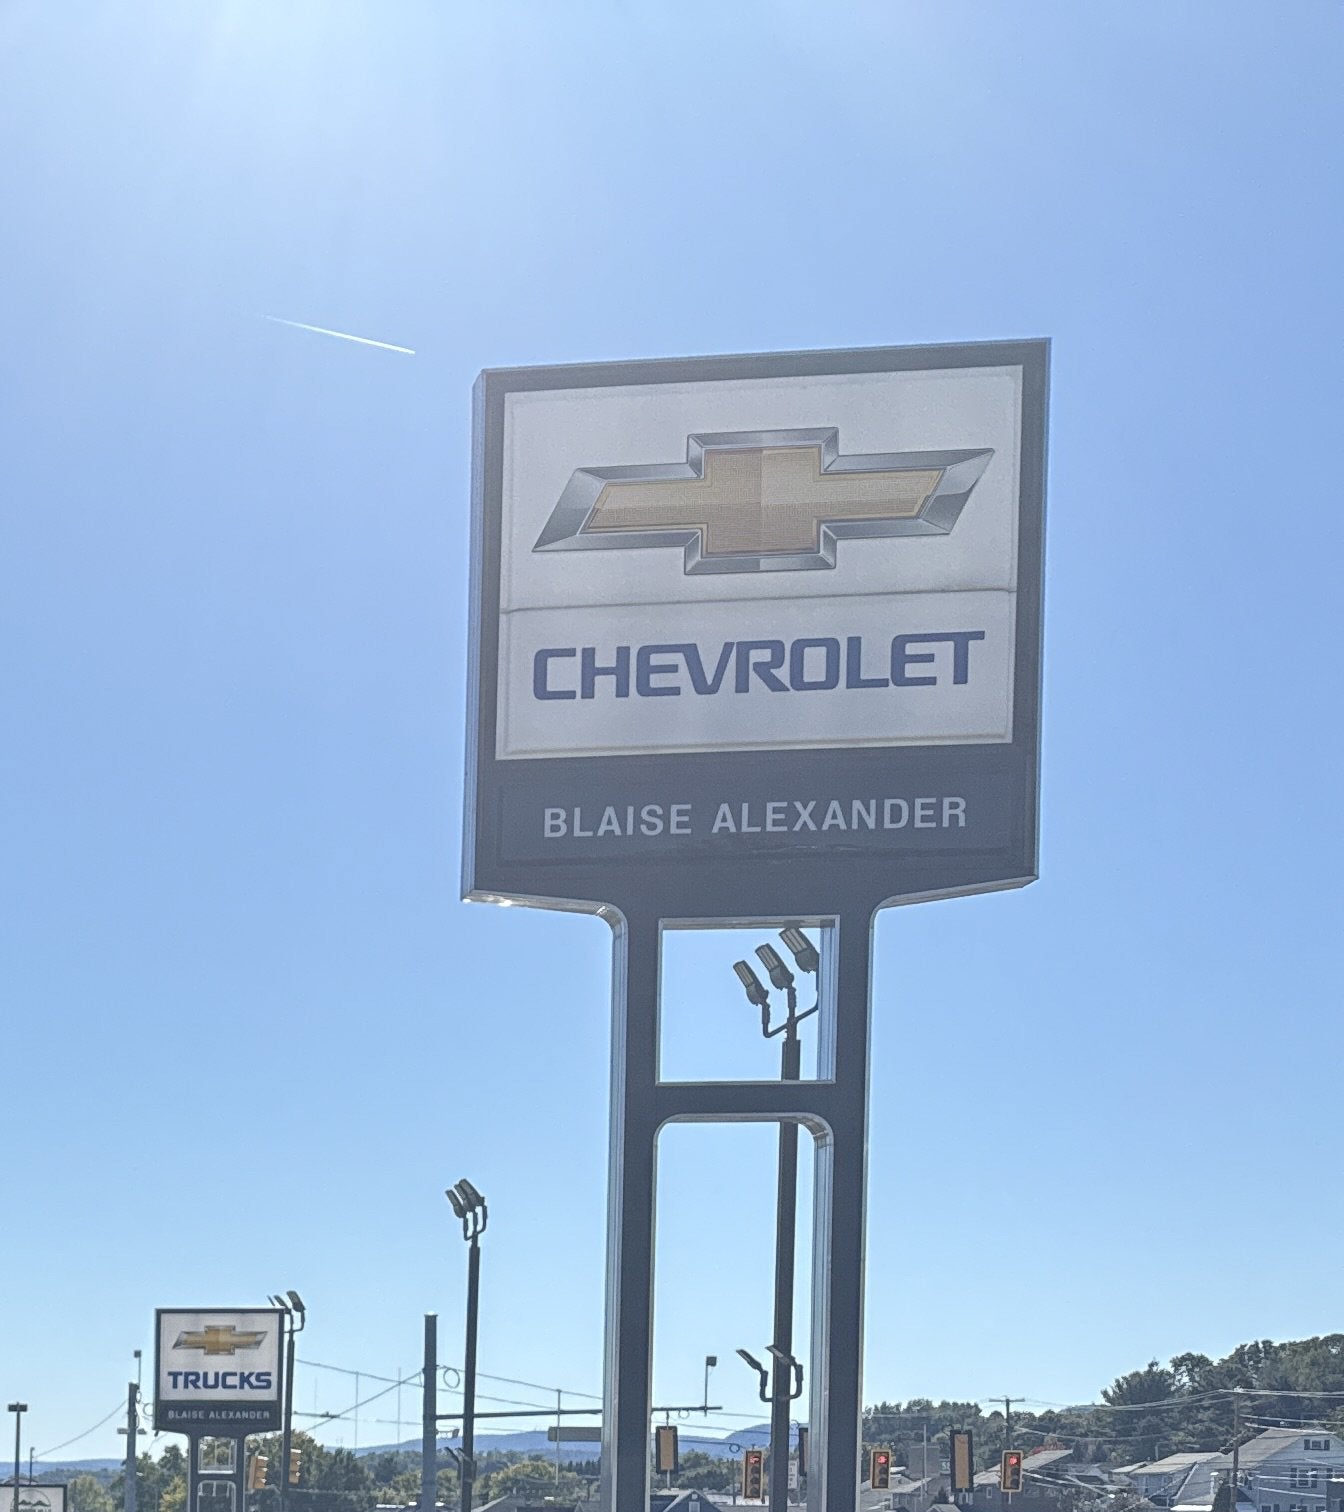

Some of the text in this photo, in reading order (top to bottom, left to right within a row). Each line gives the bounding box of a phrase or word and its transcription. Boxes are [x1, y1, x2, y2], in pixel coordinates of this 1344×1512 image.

[533, 630, 985, 700] CHEVROLET
[543, 797, 968, 838] BLAISE ALEXANDER
[167, 1371, 272, 1390] TRUCKS
[168, 1410, 270, 1420] BLAISE ALEXANDER
